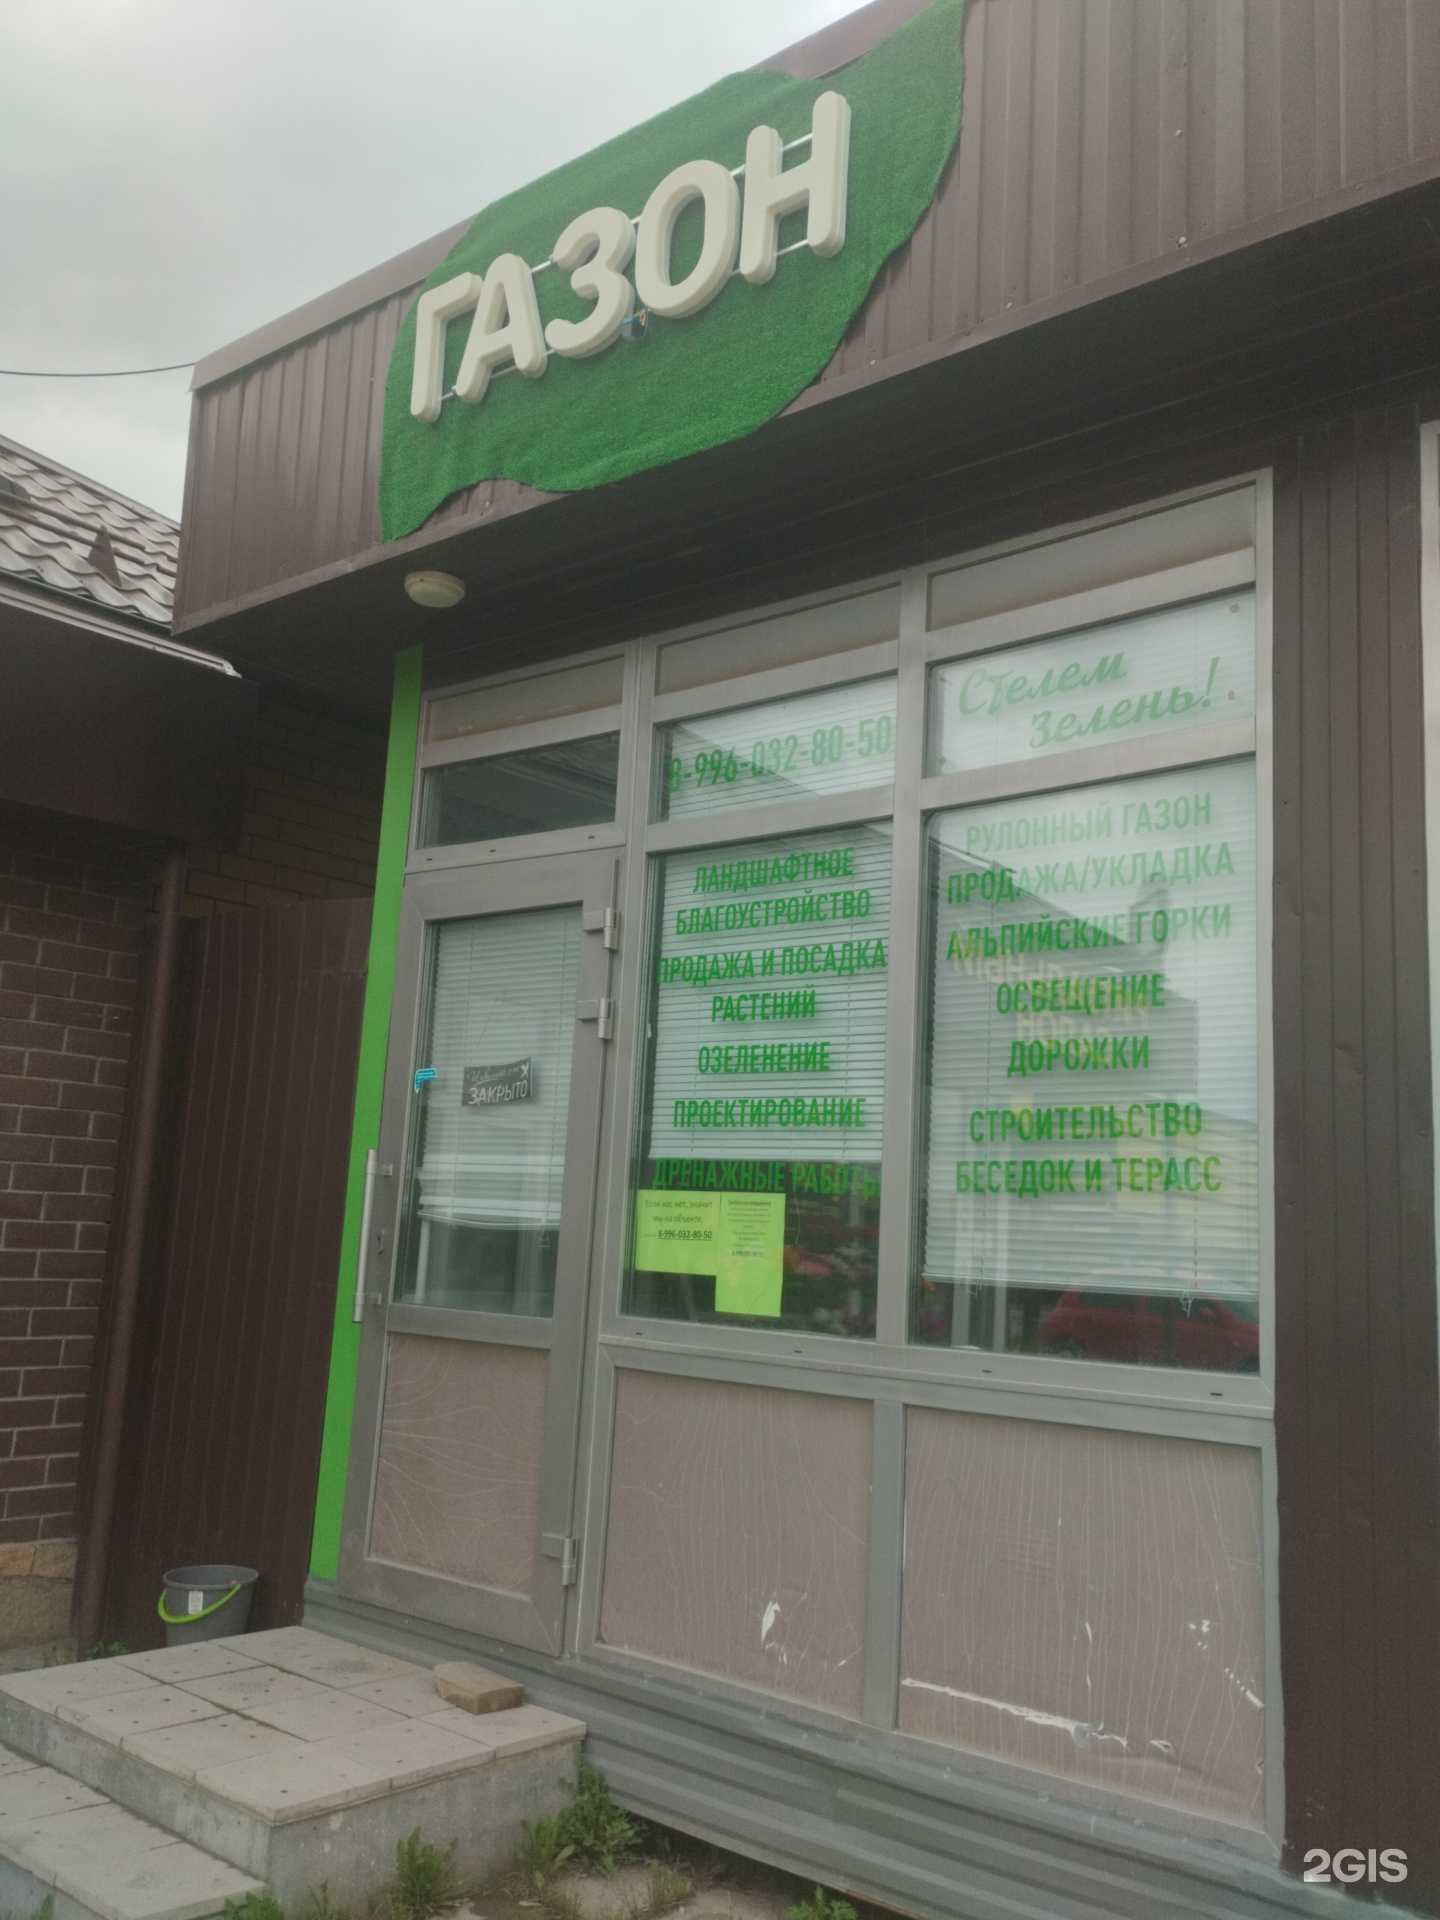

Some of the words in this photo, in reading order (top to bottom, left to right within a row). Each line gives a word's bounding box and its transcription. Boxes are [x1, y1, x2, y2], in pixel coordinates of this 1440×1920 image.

[410, 90, 851, 423] ГАЗОН
[959, 652, 1129, 716] Стелем
[966, 804, 1113, 853] РУЛОННЫЙ
[1122, 792, 1212, 836] ГАЗОН
[693, 848, 854, 893] ЛАНДШАФТНОЕ
[946, 841, 1235, 905] ПРОДАЖА/УКЛАДКА
[675, 889, 871, 936] БЛАГОУСТРОЙСТВО
[946, 914, 1130, 961] АЛЬПИЙСКИЕ
[1135, 904, 1232, 944] ГОРКИ
[657, 950, 754, 986] ПРОДАЖА
[761, 949, 775, 977] И
[780, 938, 888, 977] ПОСАДКА
[711, 985, 817, 1023] РАСТЕНИЙ
[996, 973, 1166, 1015] ОСВЕЩЕНИЕ
[698, 1041, 832, 1074] ОЗЕЛЕНЕНИЕ
[1007, 1035, 1151, 1077] ДОРОЖКИ
[468, 1080, 528, 1105] ЗАКРЫТО
[673, 1097, 867, 1128] ПРОЕКТИРОВАНИЕ
[969, 1102, 1202, 1143] СТРОИТЕЛЬСТВО
[652, 1157, 786, 1192] ДРЕНАЖНЫЕ
[956, 1158, 1076, 1198] БЕСЕДОК
[1085, 1157, 1102, 1192] И
[1112, 1156, 1223, 1193] ТЕРАСС
